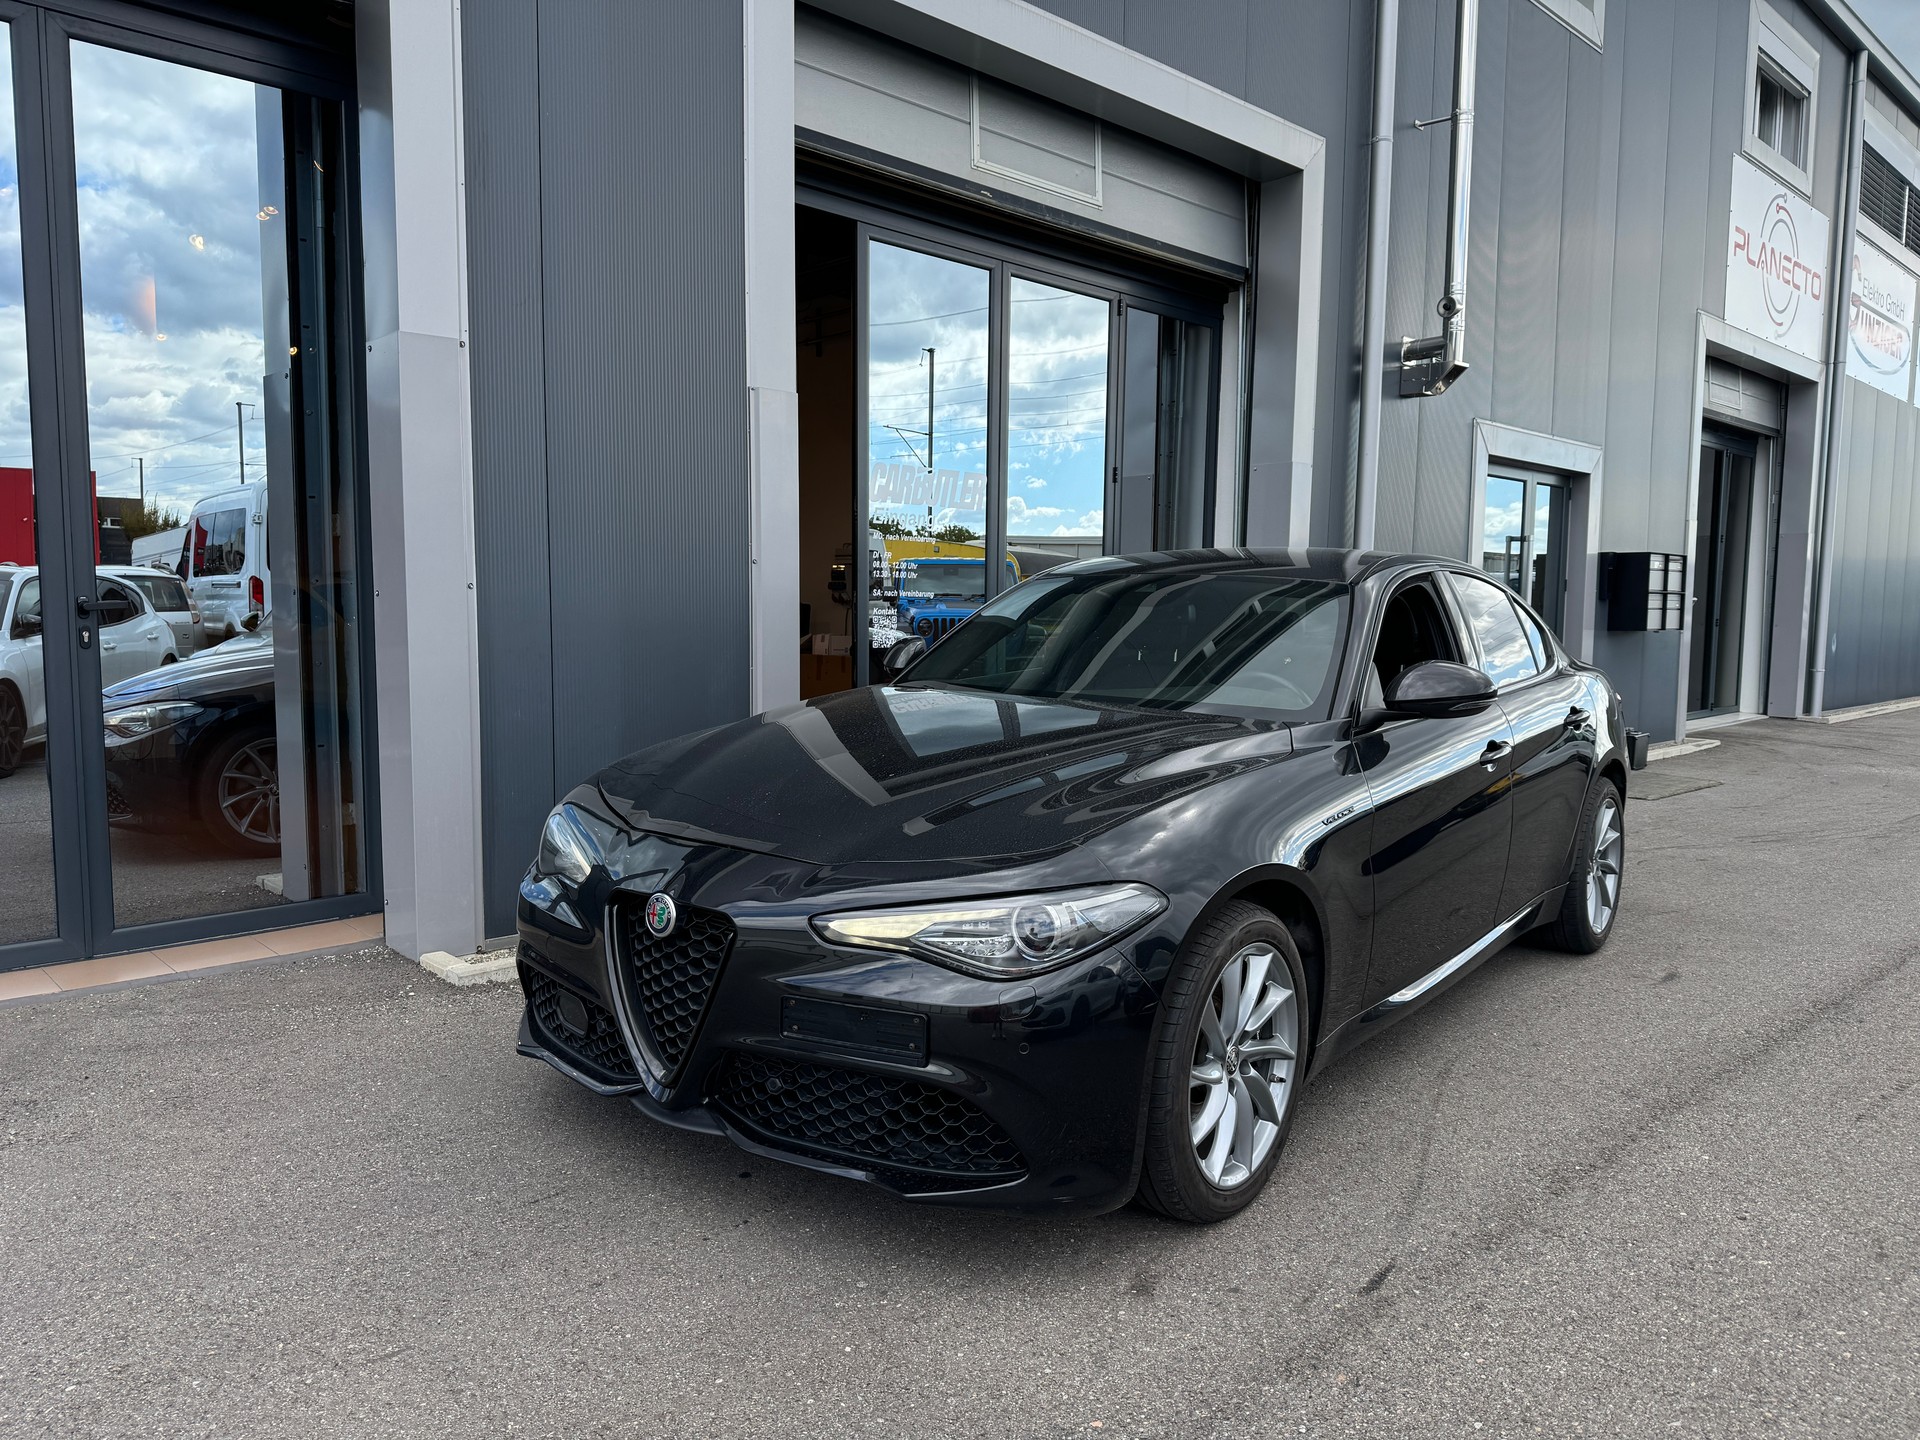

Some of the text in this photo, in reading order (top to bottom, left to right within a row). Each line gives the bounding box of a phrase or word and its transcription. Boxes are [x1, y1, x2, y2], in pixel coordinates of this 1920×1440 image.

[1734, 226, 1821, 300] PLANECTO
[1863, 277, 1905, 320] Elektro GmbH
[869, 462, 987, 511] CARBUTLER
[872, 507, 935, 531] Eingang
[885, 533, 899, 541] nach
[900, 534, 936, 544] Vereinbarung
[873, 589, 884, 597] SA:
[899, 590, 934, 599] Vereinbarung
